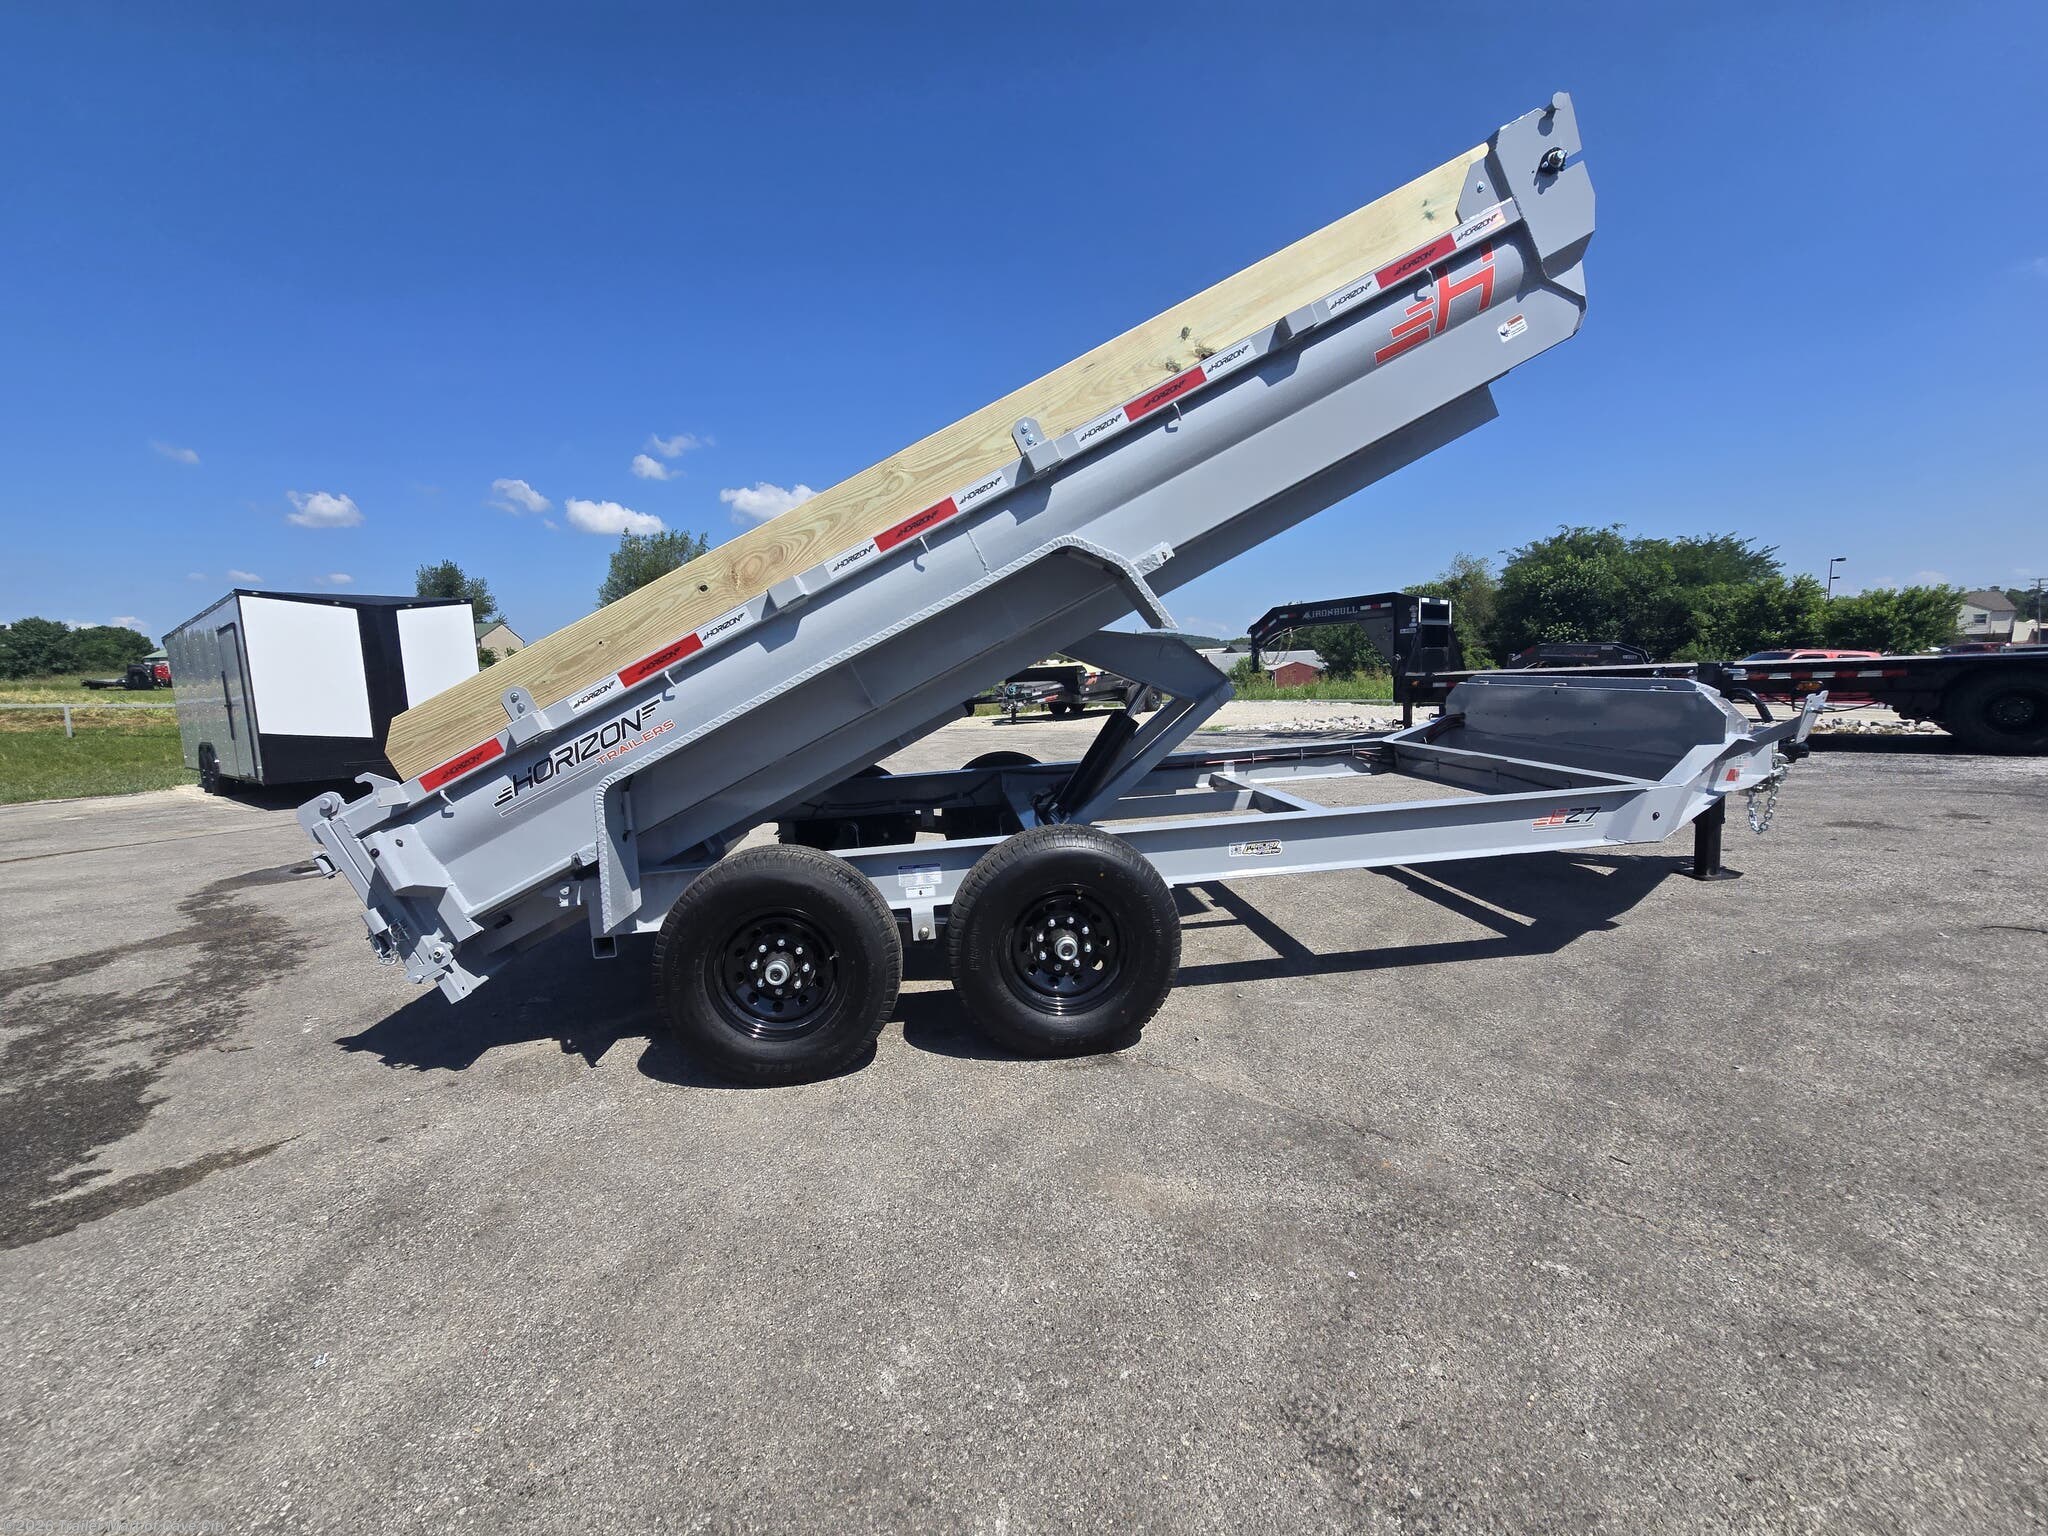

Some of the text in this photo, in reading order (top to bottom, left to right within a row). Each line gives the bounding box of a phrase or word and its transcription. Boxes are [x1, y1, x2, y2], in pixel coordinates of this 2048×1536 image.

[1458, 213, 1497, 241] HORIZON
[1396, 248, 1435, 274] HORIZON
[1332, 282, 1371, 309] HORIZON
[1209, 346, 1248, 371] HORIZON
[1146, 381, 1184, 407] HORIZON
[1082, 414, 1121, 440] HORIZON
[961, 477, 1001, 503] HORIZON
[898, 511, 937, 537] HORIZON
[835, 545, 874, 571] HORIZON
[1311, 606, 1358, 618] IRONBULL
[704, 613, 743, 639] HORIZON
[640, 648, 680, 674] HORIZON
[575, 682, 614, 707] HORIZON
[508, 708, 650, 799] HORIZON
[597, 720, 676, 766] TRAILERS
